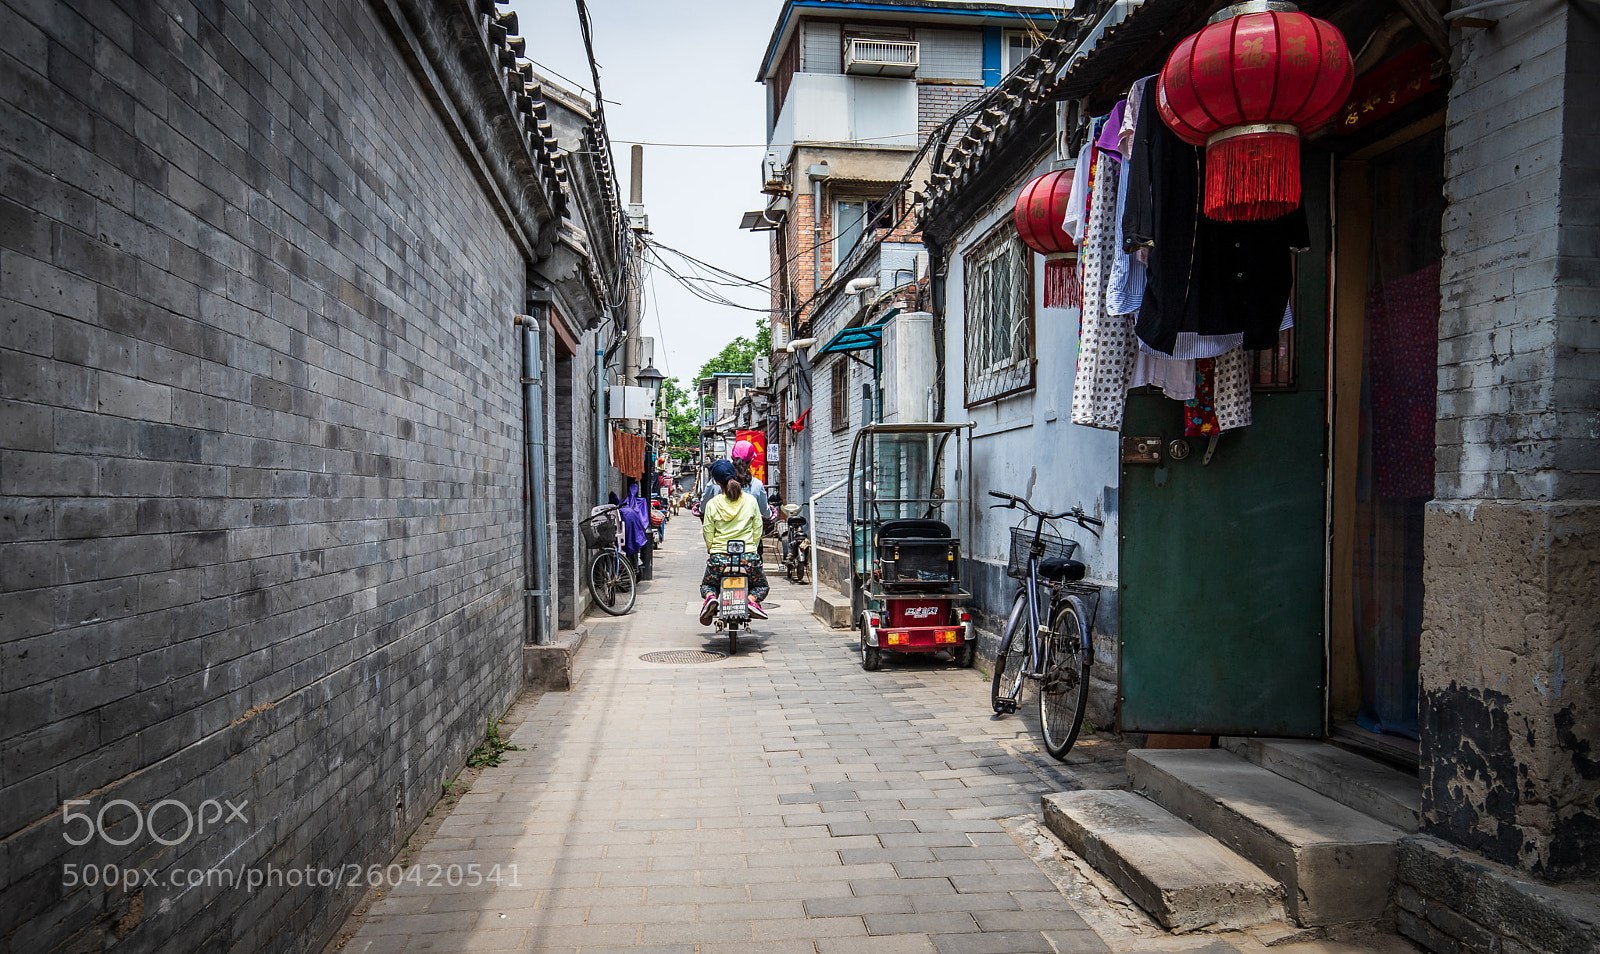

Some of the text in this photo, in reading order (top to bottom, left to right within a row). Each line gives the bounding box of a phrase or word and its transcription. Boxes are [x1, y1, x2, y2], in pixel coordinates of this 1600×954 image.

[1197, 43, 1226, 77] 福
[1238, 36, 1270, 69] 福
[1283, 35, 1312, 67] 福
[1324, 39, 1343, 72] 福
[1030, 197, 1046, 220] 福
